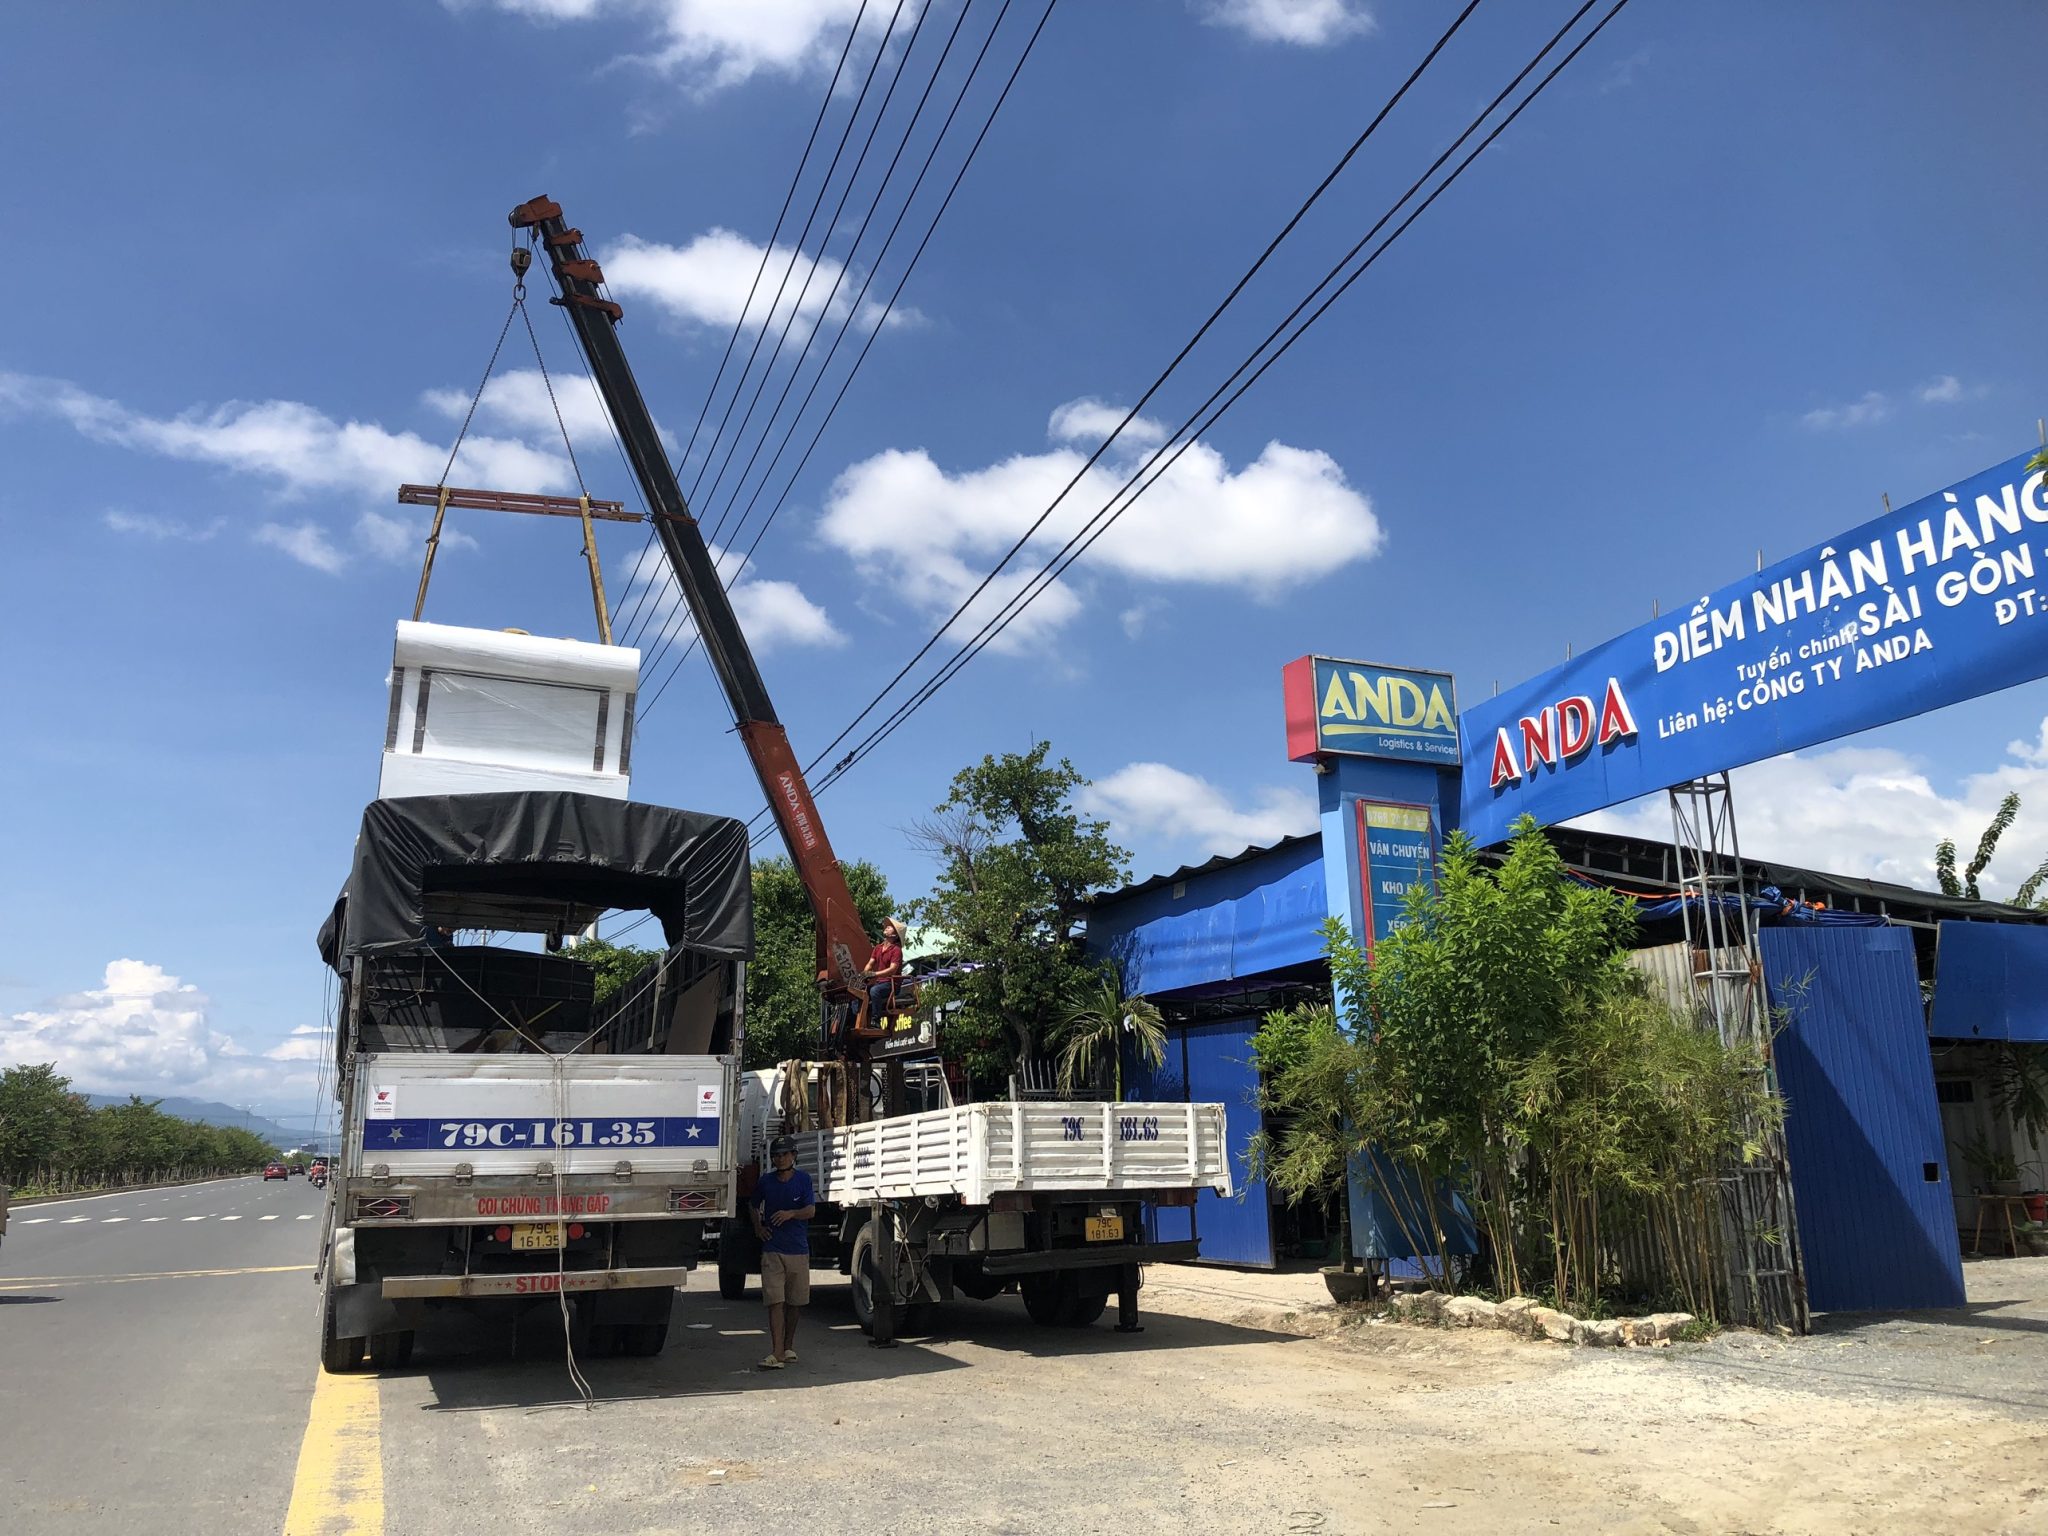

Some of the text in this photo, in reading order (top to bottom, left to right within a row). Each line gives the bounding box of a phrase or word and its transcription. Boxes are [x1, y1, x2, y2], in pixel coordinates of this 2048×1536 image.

[1654, 471, 2048, 673] ĐIỂM NHẬN HÀNG
[1737, 646, 1791, 681] Tuyến
[1859, 585, 1922, 636] SÀI
[1936, 551, 2035, 607] GÒN
[1995, 588, 2048, 626] ĐT:
[1659, 627, 1933, 739] Liên hệ: CÔNG TY ANDA
[1321, 670, 1456, 732] ANDA
[1490, 677, 1638, 788] ANDA
[1378, 737, 1458, 755] Logistics & Services
[1369, 840, 1390, 857] VẬN
[1382, 881, 1404, 894] KHO
[440, 1122, 656, 1147] 79C-161.35
[1062, 1117, 1158, 1141] 79C 181.63
[478, 1198, 497, 1214] COI
[529, 1223, 551, 1234] 79C
[1096, 1219, 1112, 1228] 79C
[520, 1235, 560, 1247] 161.35
[516, 1275, 565, 1292] STOP
